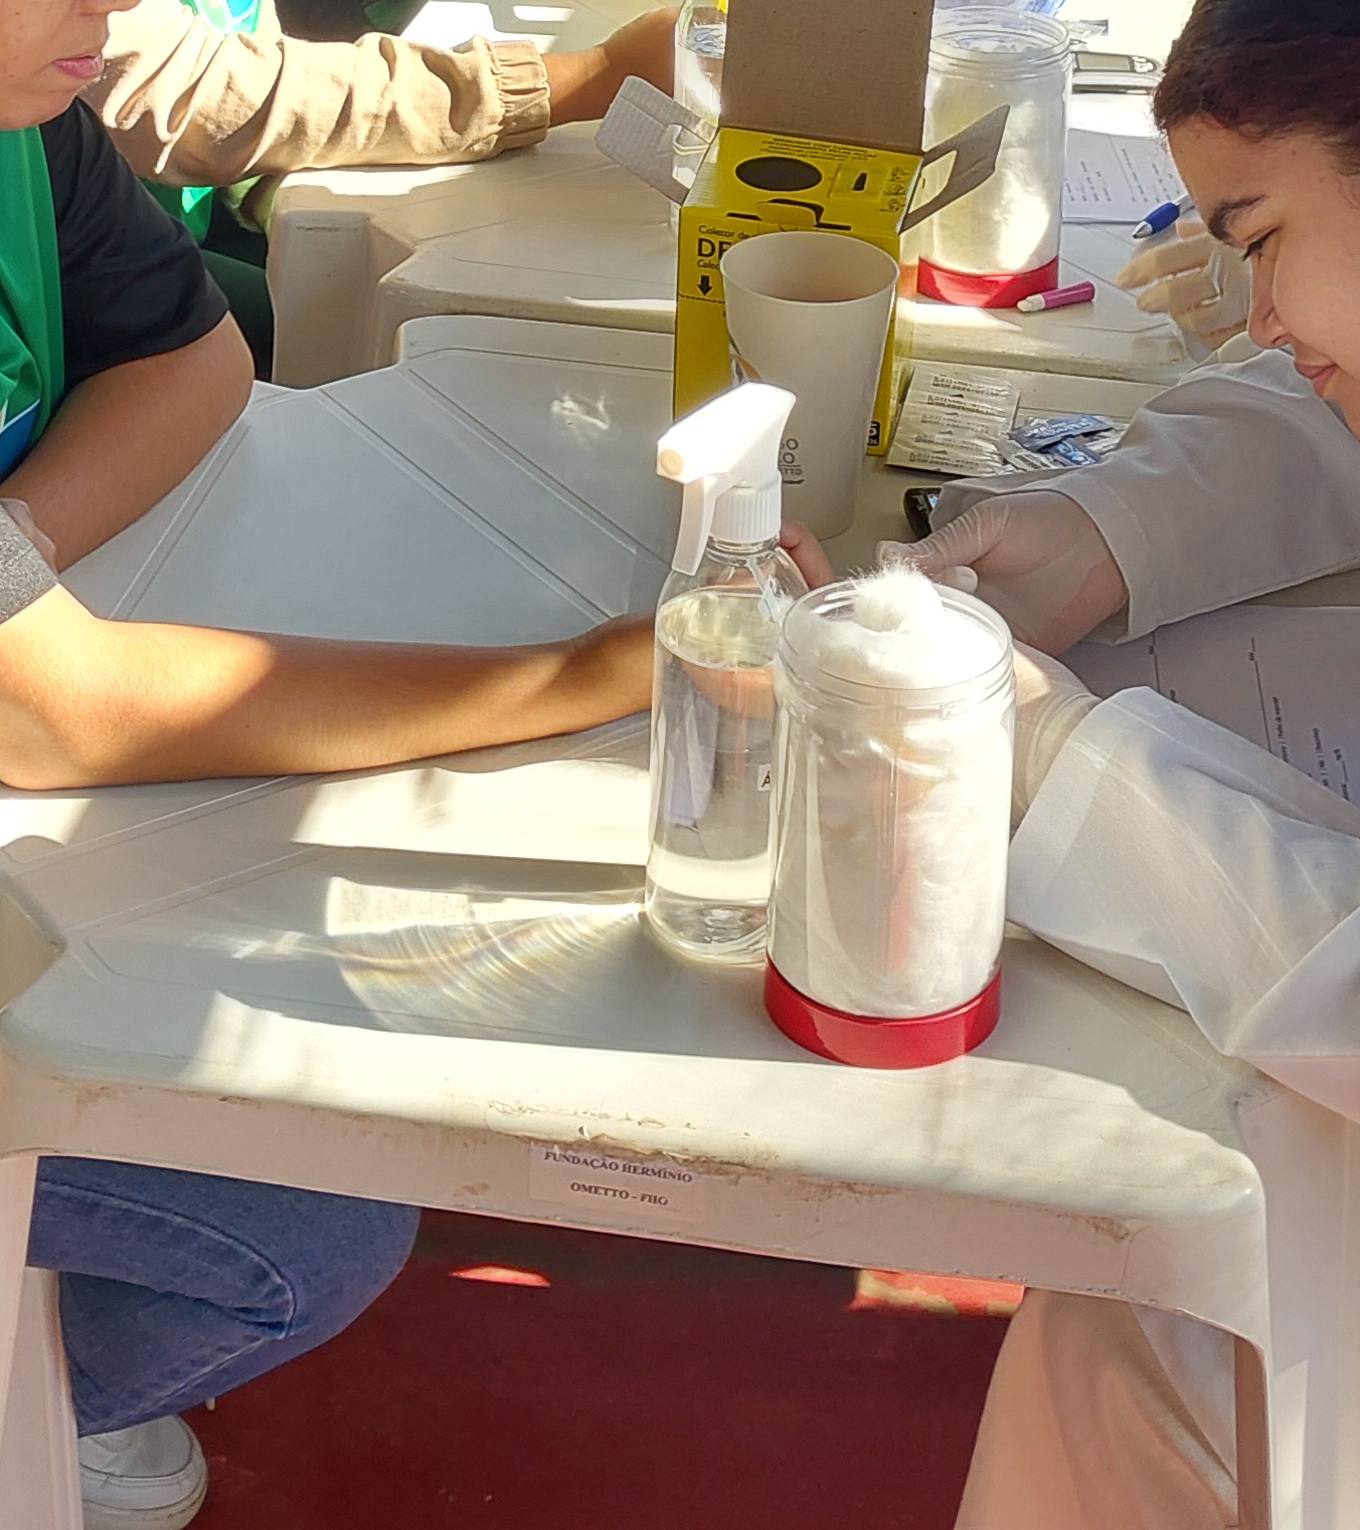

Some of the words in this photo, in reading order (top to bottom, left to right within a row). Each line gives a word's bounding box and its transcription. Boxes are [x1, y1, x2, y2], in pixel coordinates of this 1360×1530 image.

[698, 225, 735, 238] Coletor
[544, 1151, 620, 1172] FUNDAÇÃO
[570, 1182, 630, 1200] OMETTO
